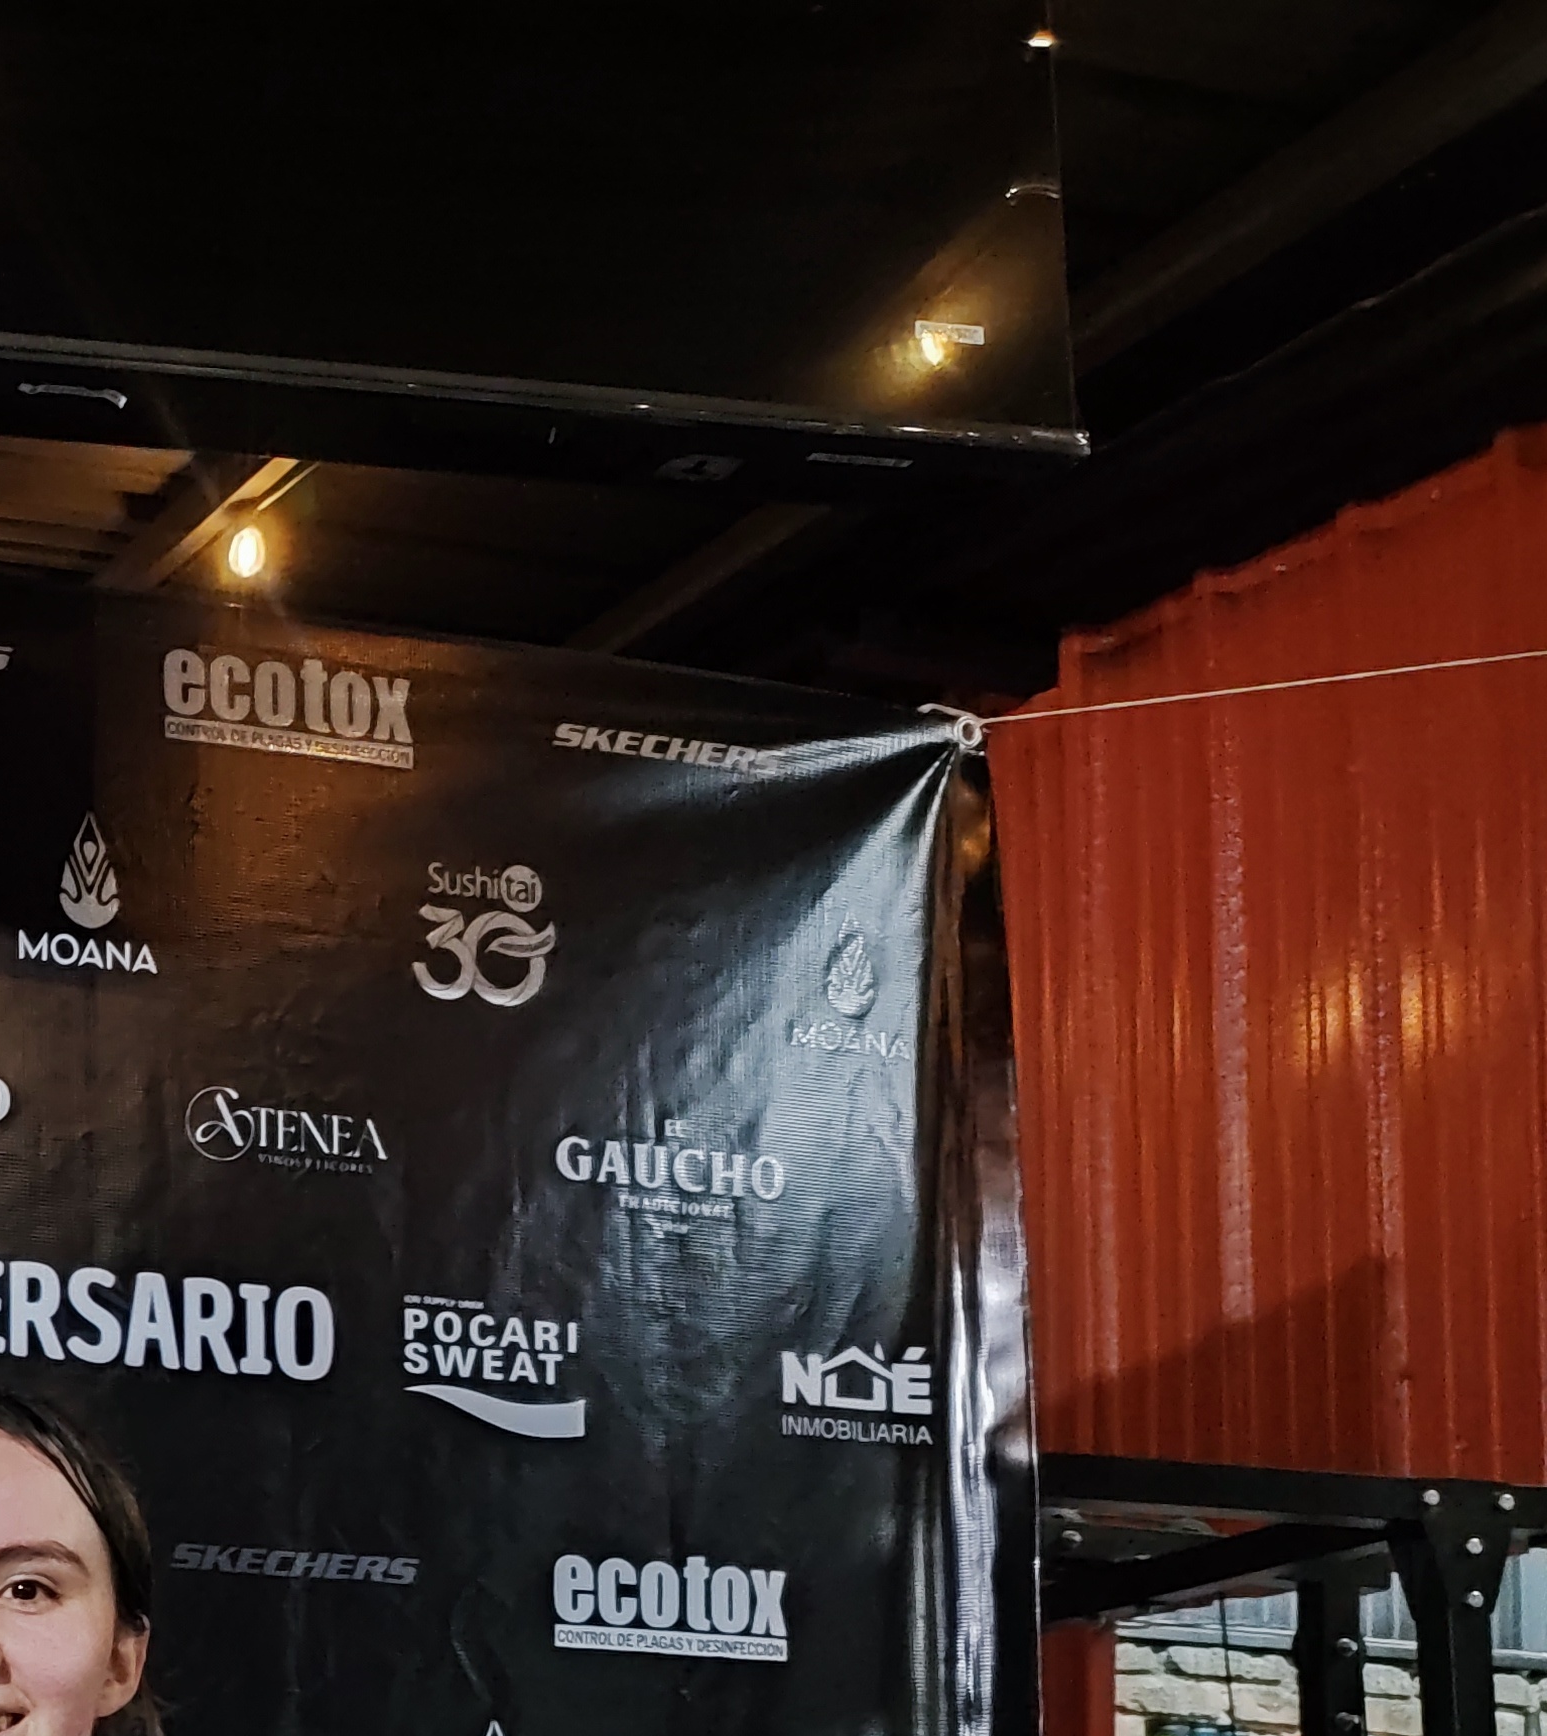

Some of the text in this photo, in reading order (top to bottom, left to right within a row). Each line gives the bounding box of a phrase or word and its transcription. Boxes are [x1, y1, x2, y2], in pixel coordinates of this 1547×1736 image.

[163, 648, 414, 743] ecotox
[552, 722, 779, 774] SKECHERS
[18, 932, 158, 975] MOANA
[791, 1021, 910, 1060] MOANA
[556, 1135, 785, 1200] GAUCHO
[404, 1307, 578, 1354] POCARI
[403, 1341, 564, 1385] SWEAT
[781, 1414, 934, 1446] INMOBILIARIA
[171, 1542, 419, 1585] SKECHERS
[553, 1554, 788, 1637] ecotox
[557, 1629, 614, 1647] CONTROL
[617, 1632, 634, 1648] DE
[636, 1634, 684, 1651] PLAGAS
[686, 1638, 693, 1651] Y
